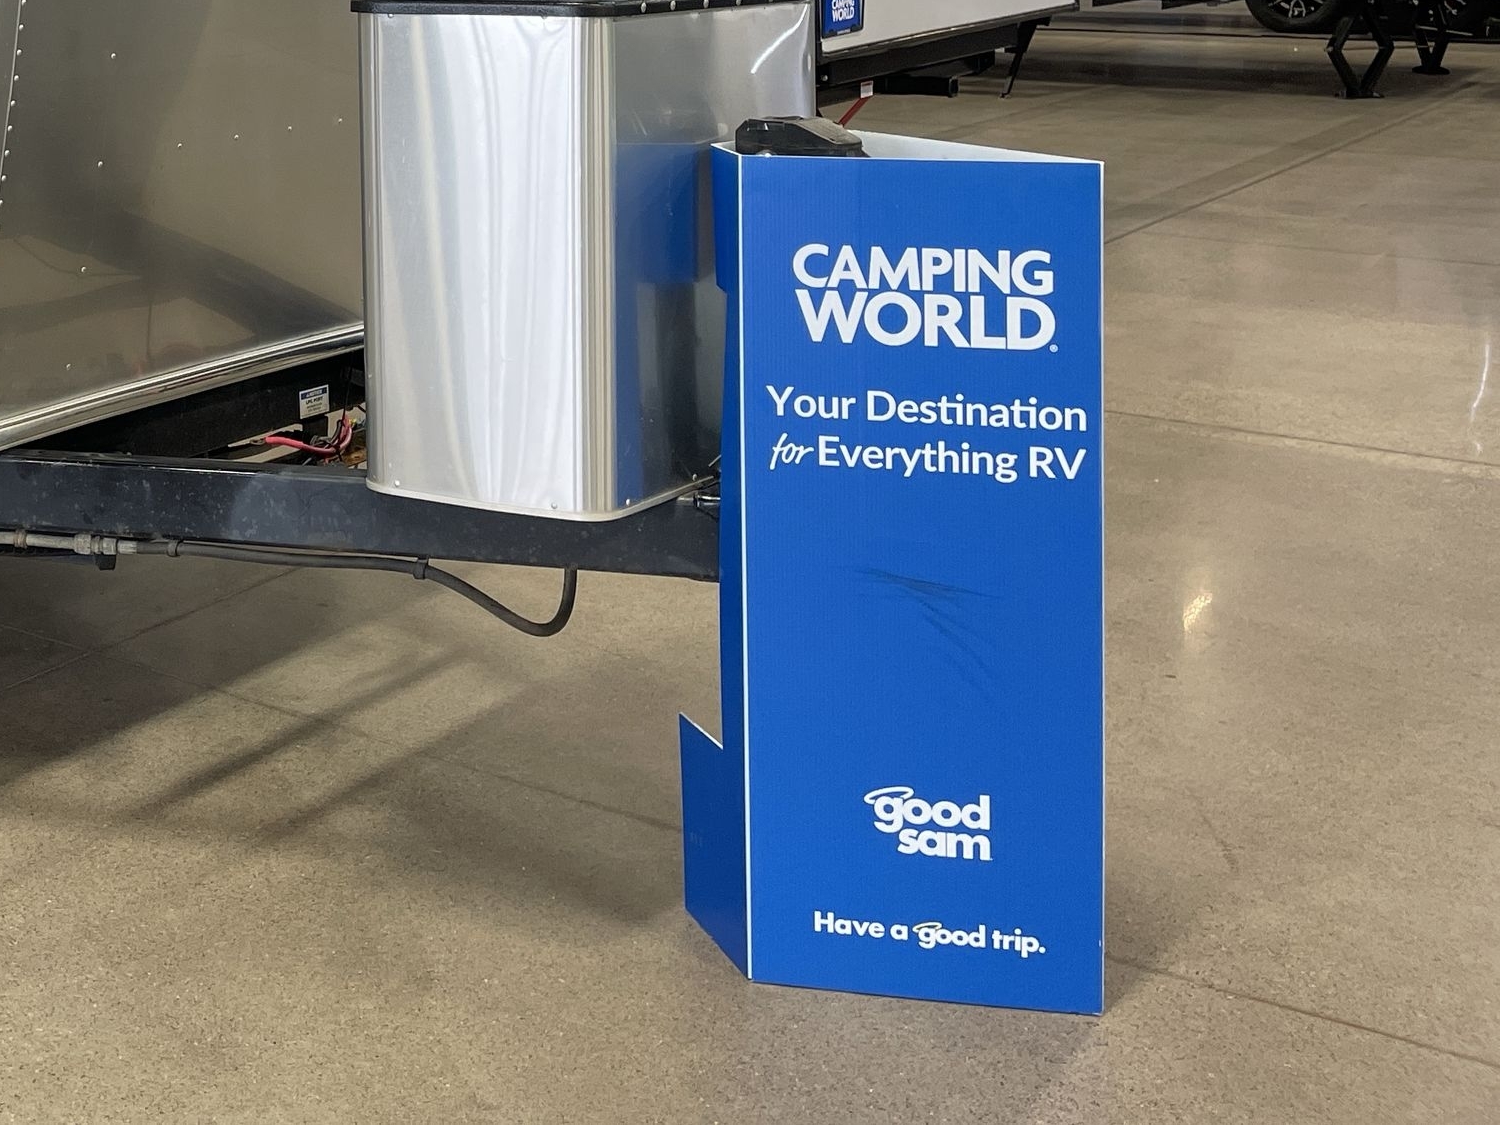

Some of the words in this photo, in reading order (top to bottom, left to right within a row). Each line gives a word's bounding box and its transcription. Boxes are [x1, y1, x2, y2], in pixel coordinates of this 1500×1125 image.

[831, 6, 855, 22] WORLD
[793, 243, 1055, 297] CAMPING
[766, 386, 856, 419] Your
[867, 390, 1088, 432] Destination
[769, 433, 814, 470] for
[818, 435, 1018, 483] Everything
[1028, 447, 1087, 480] RV
[872, 791, 991, 833] good
[897, 828, 992, 861] sam
[814, 911, 885, 939] Have
[890, 923, 908, 941] a
[916, 923, 986, 949] good
[992, 927, 1046, 958] trip.
